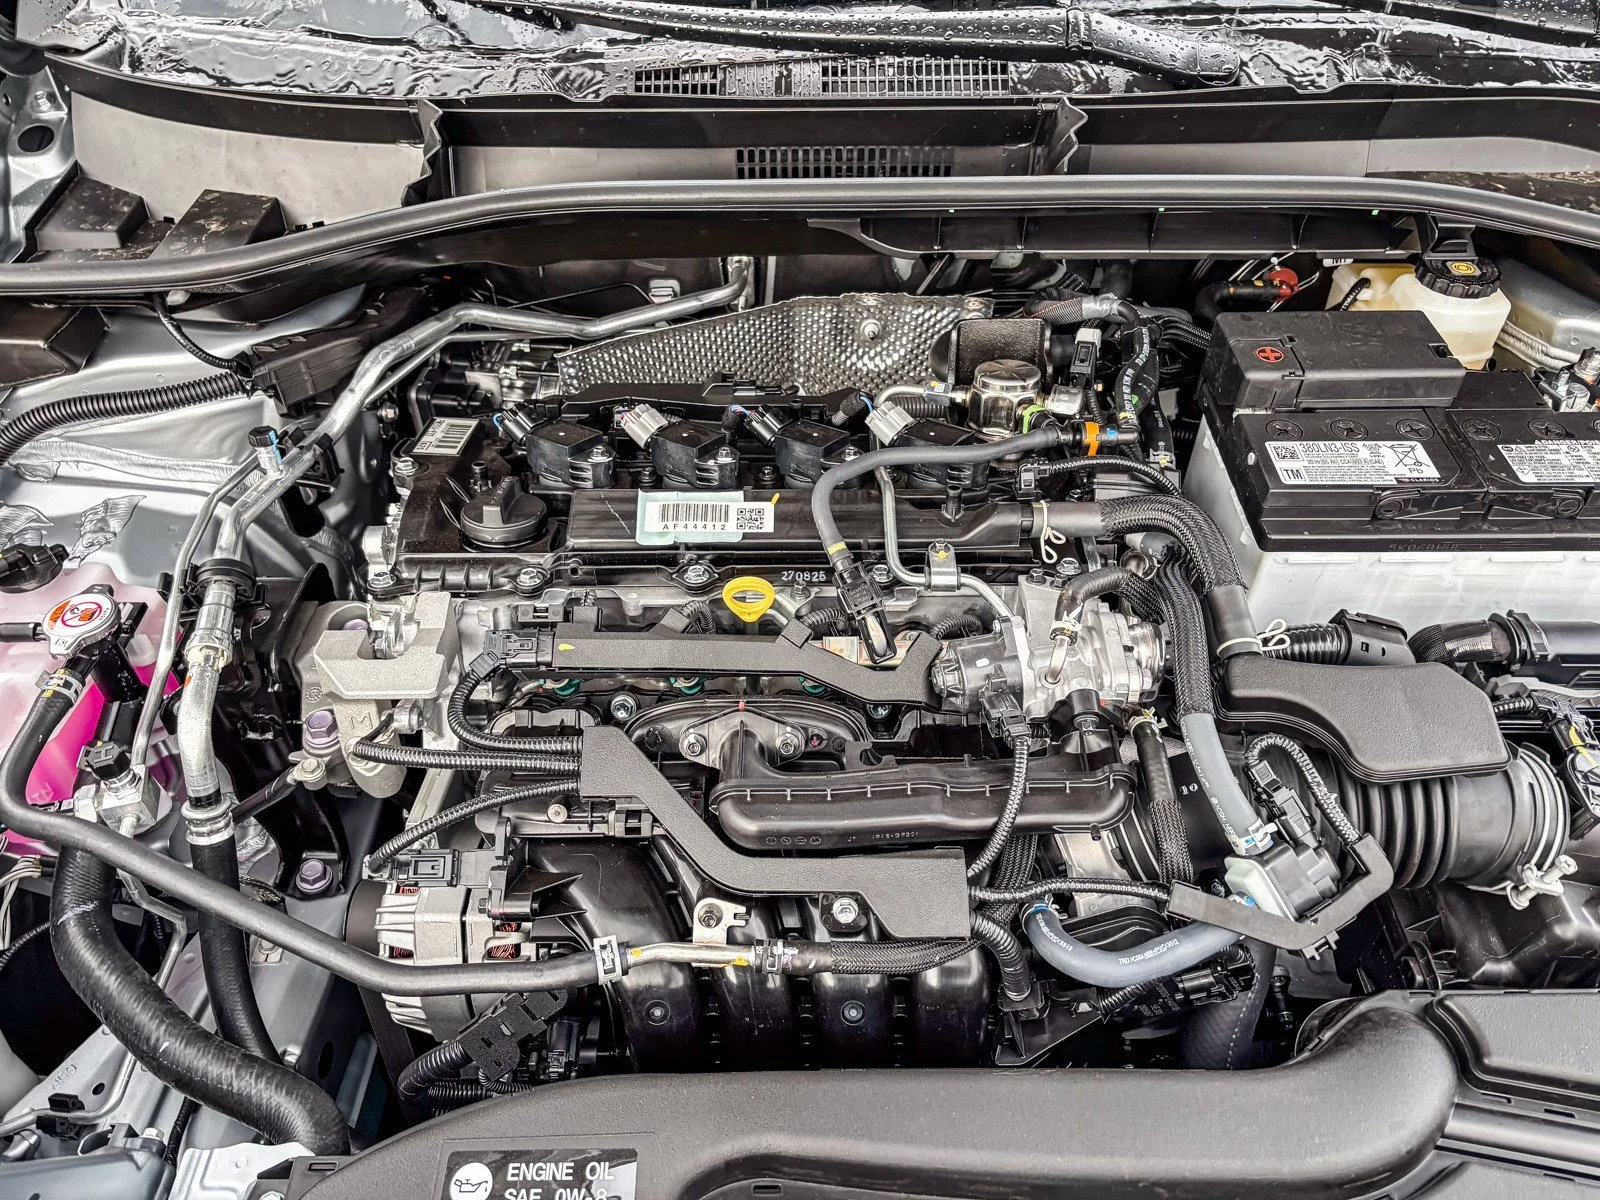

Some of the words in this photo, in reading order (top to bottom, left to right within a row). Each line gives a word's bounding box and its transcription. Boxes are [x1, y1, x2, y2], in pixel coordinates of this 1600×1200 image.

[1299, 442, 1361, 454] 380LN3-ISS
[1283, 469, 1303, 481] TM
[1408, 467, 1424, 475] Pb
[506, 1162, 574, 1181] ENGINE
[585, 1161, 615, 1181] OIL
